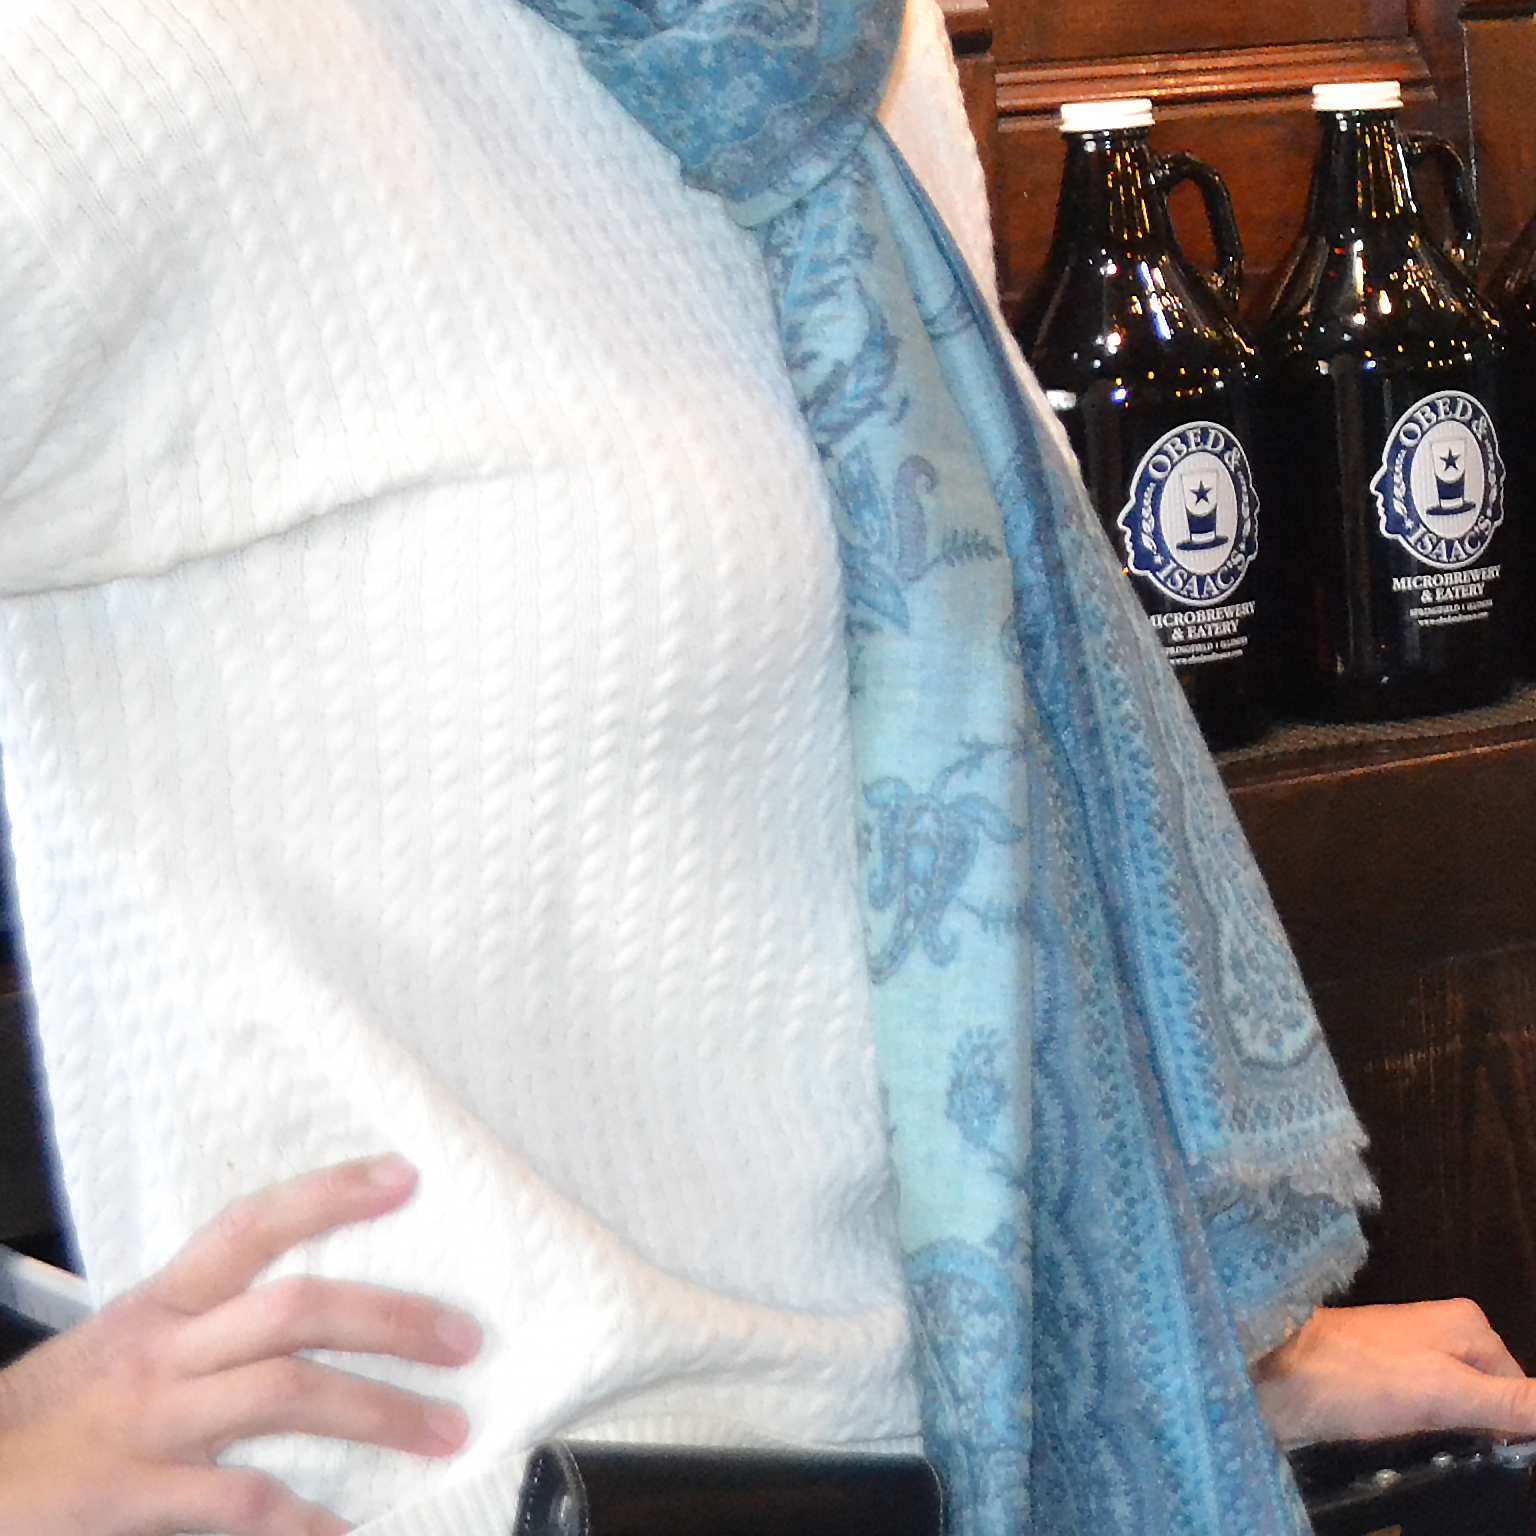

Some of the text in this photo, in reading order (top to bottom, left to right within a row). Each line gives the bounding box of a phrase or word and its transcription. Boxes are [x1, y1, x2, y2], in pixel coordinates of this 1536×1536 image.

[1399, 397, 1473, 448] OBED
[1148, 427, 1215, 480] OBED
[1407, 515, 1492, 563] ISAAC'S
[1155, 548, 1247, 600] ISAAC'S
[1392, 565, 1501, 592] MICROBREWERY
[1435, 581, 1485, 601] EATERY
[1186, 618, 1240, 640] EATERY
